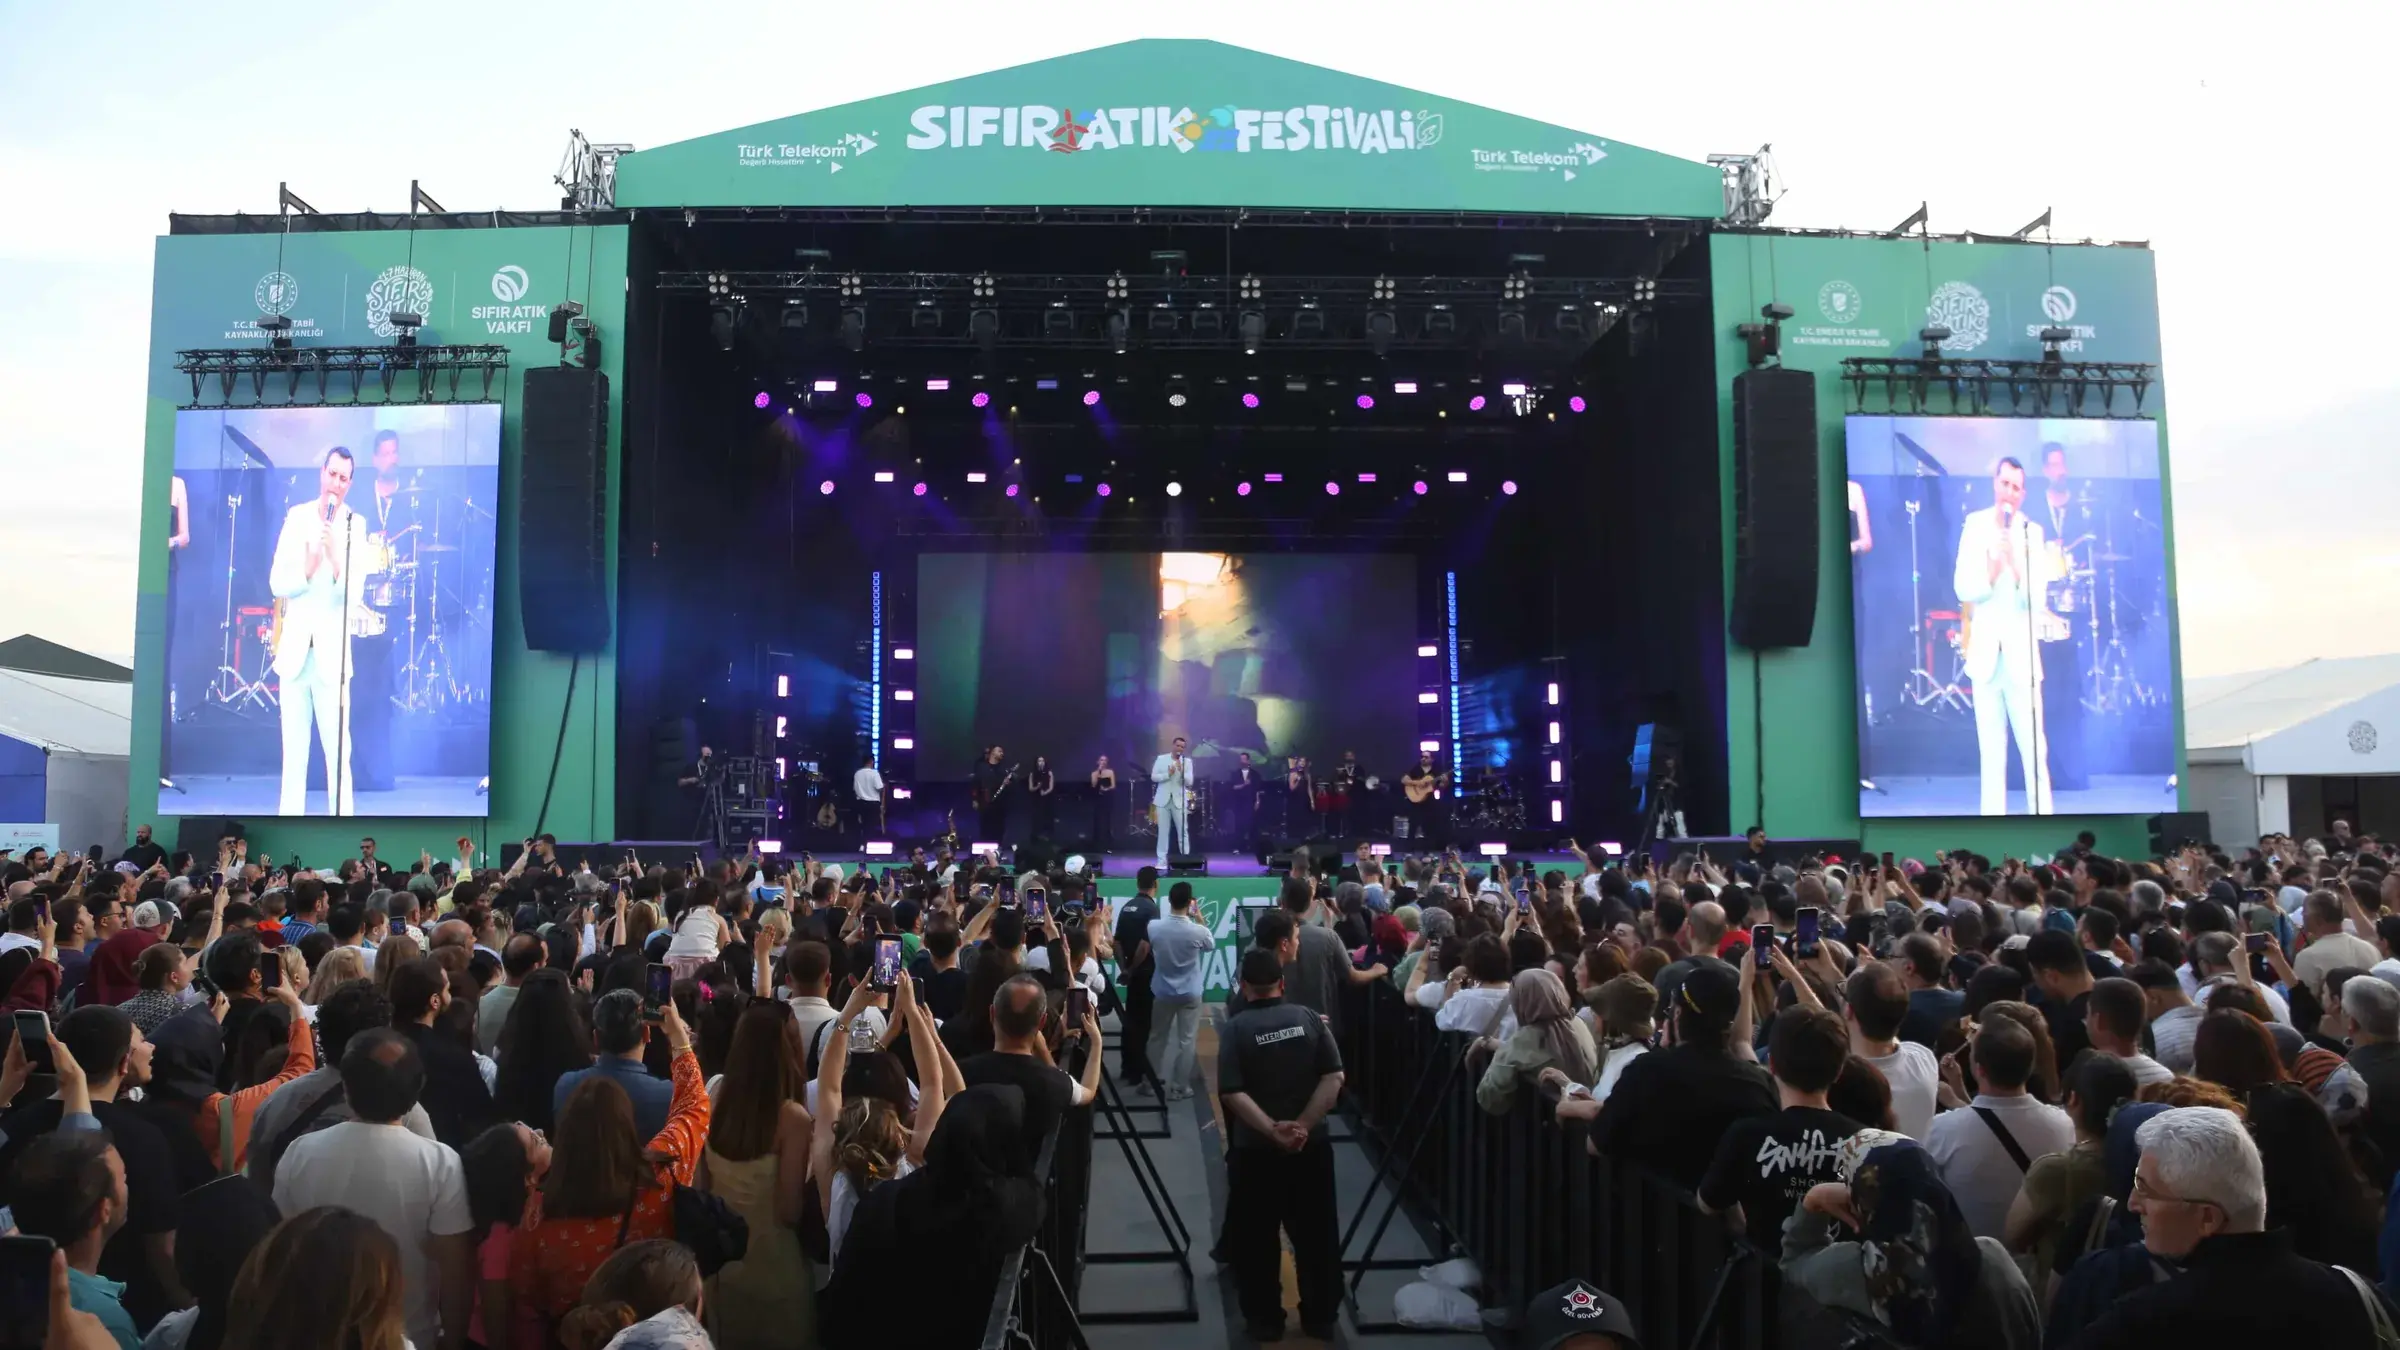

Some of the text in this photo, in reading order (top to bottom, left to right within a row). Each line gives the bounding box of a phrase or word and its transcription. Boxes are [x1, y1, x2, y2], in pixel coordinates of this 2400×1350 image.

[907, 105, 1059, 151] SIFIR
[1080, 106, 1196, 153] ATIK
[738, 144, 847, 158] Türk Telekom
[1471, 149, 1579, 166] Türk Telekom
[369, 279, 428, 311] SIFIR
[471, 305, 547, 319] SIFIR ATIK
[233, 321, 248, 329] T.C.
[486, 320, 531, 334] VAKFI
[1255, 1031, 1280, 1043] INTER
